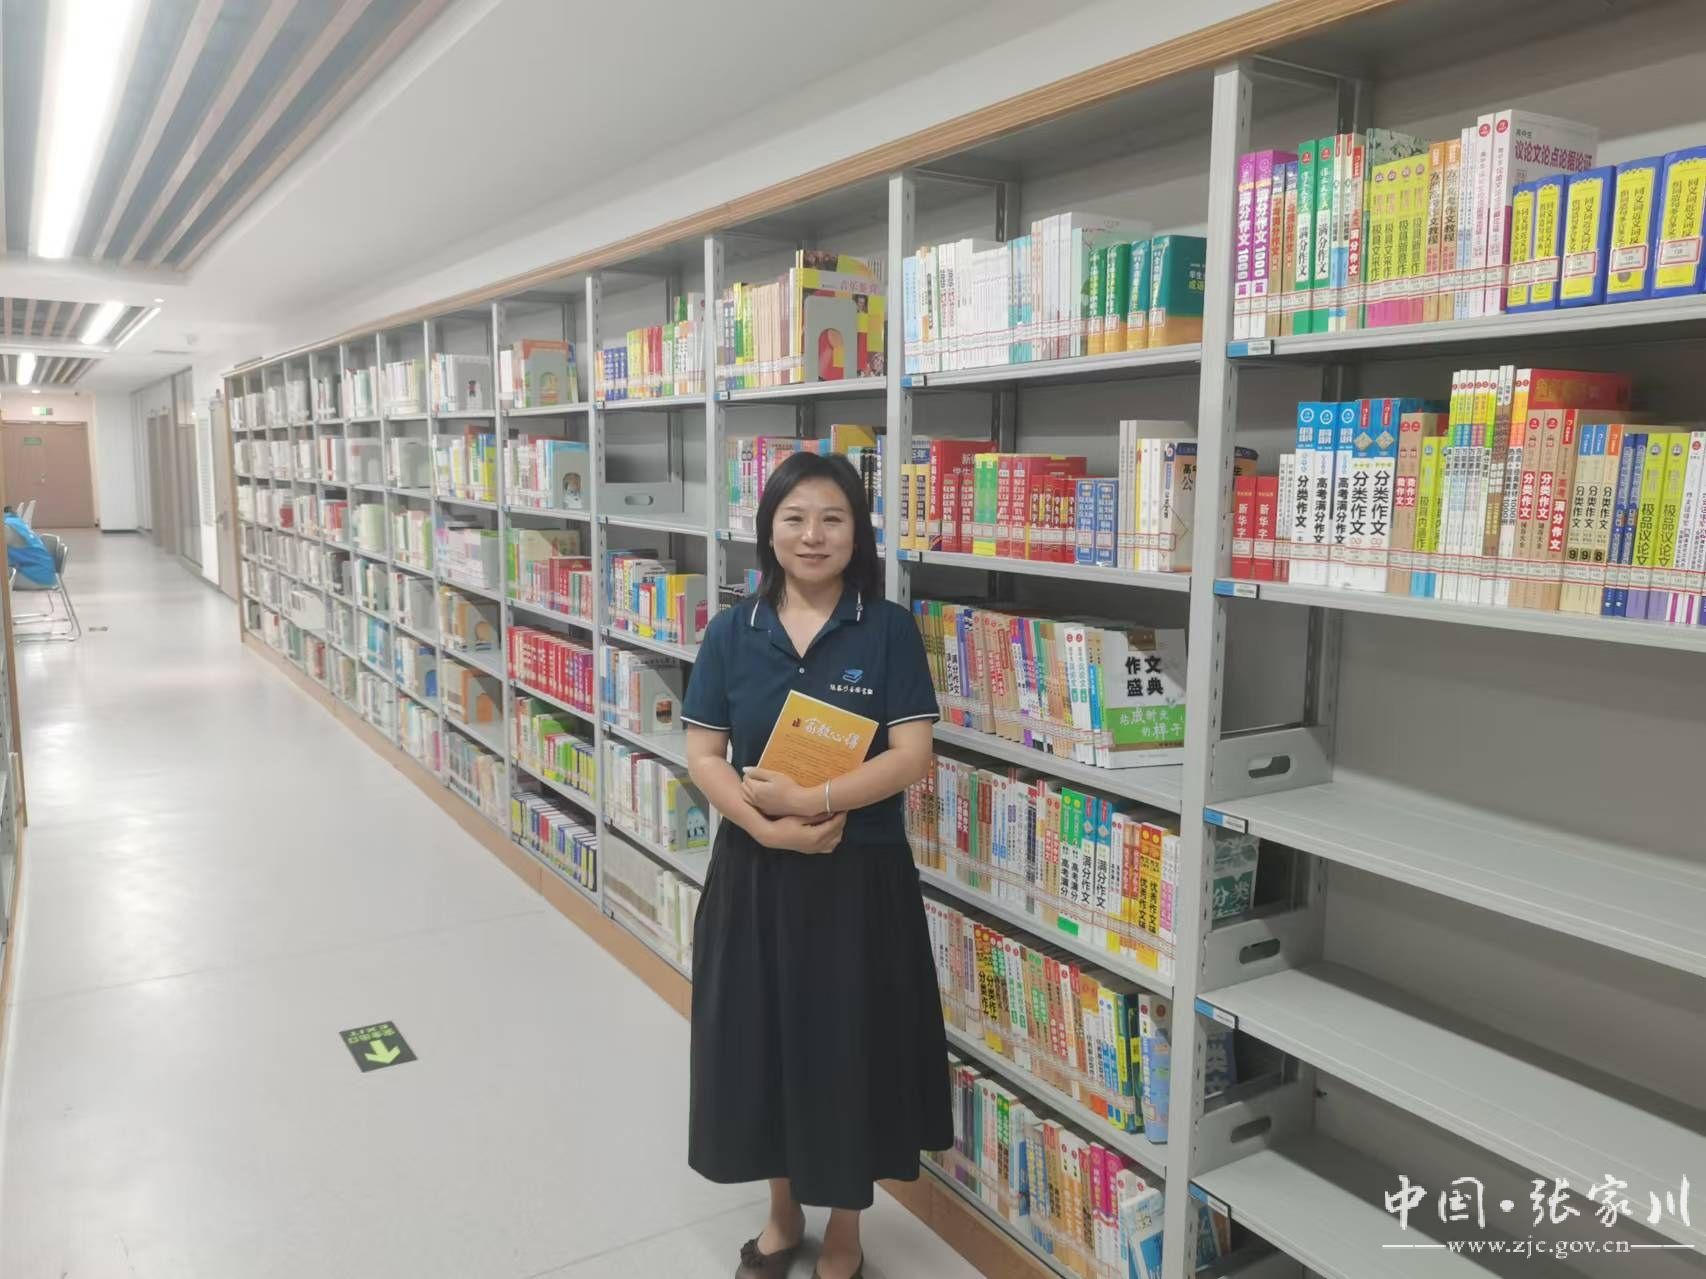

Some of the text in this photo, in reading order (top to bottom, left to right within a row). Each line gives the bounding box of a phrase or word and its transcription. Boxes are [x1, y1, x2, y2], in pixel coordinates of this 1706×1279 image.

[1295, 475, 1309, 528] 分类作文
[1314, 477, 1329, 544] 高考满分作文
[1334, 477, 1349, 544] 高考满分作文
[1349, 471, 1370, 536] 分类作文
[1370, 470, 1390, 536] 分类作文
[1519, 472, 1534, 519] 分类作文
[1537, 472, 1552, 519] 分类作文
[1571, 485, 1585, 529] 分类作文
[1584, 485, 1598, 529] 分类作文
[1599, 486, 1612, 530] 分类作文
[1549, 500, 1566, 550] 满分作文
[1125, 655, 1162, 675] 作文
[1127, 678, 1164, 697] 盛典
